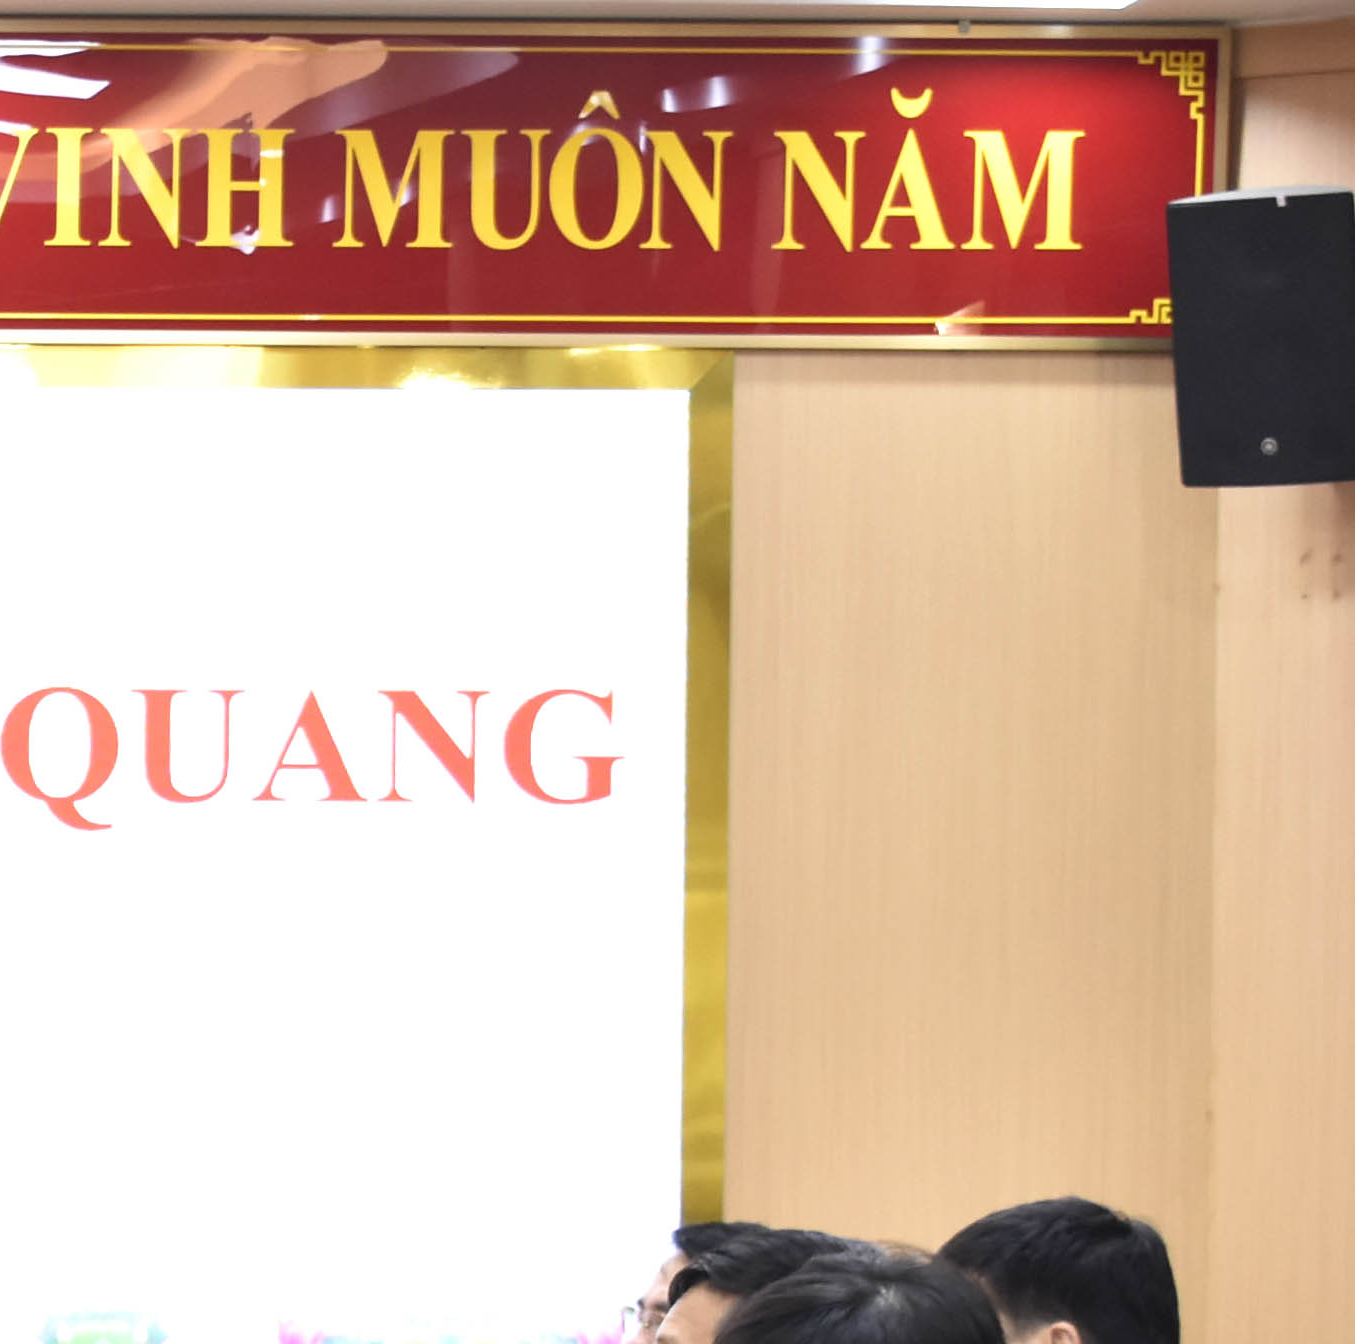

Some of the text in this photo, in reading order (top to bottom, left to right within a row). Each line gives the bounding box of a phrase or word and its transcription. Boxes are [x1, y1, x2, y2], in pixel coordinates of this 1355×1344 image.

[333, 91, 733, 252] MUÔN
[771, 87, 1087, 253] NĂM
[0, 686, 624, 832] QUANG
